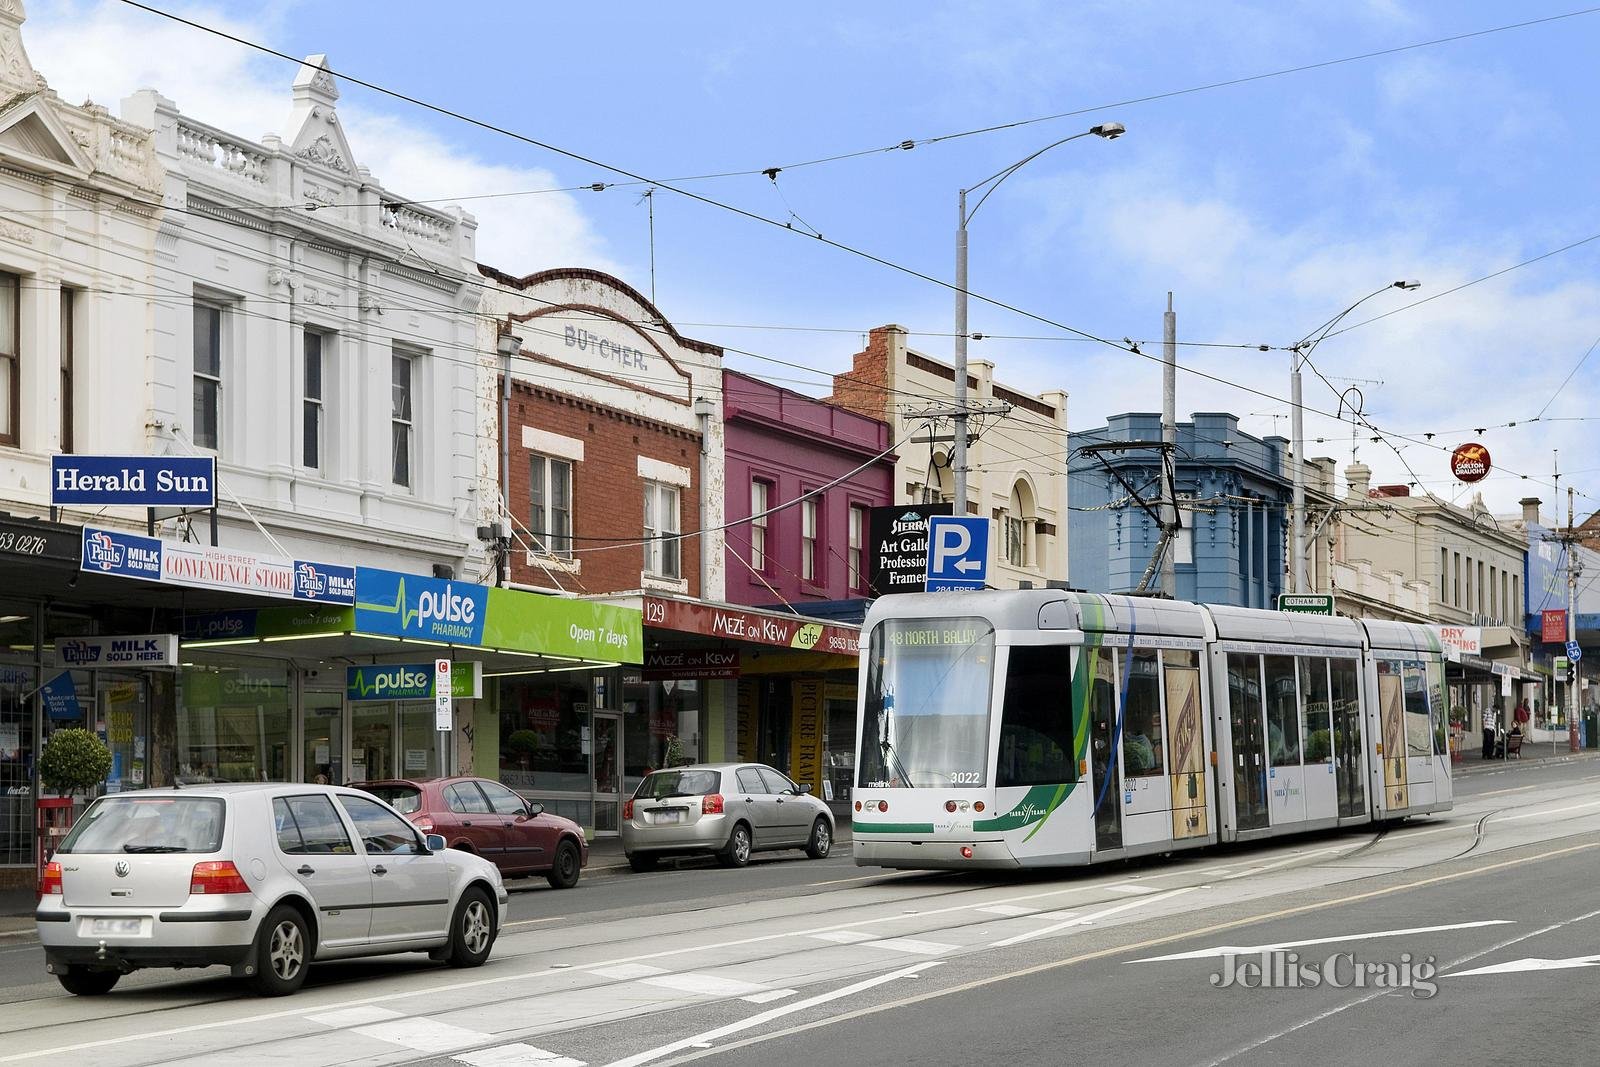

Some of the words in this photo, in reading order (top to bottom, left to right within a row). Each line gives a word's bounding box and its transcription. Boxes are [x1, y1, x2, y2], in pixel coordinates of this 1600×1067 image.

[1456, 462, 1484, 470] CARLTON
[56, 469, 147, 492] Herald
[156, 470, 209, 492] Sun
[891, 518, 929, 535] SIERRA
[15, 534, 47, 555] 0276
[880, 539, 898, 553] Art
[933, 523, 972, 574] P
[91, 543, 120, 563] Pauls
[128, 547, 159, 563] MILK
[205, 551, 227, 562] HIGH
[227, 554, 257, 566] STREET
[128, 561, 143, 570] SOLD
[143, 563, 159, 572] HERE
[880, 554, 928, 569] Professio
[166, 555, 251, 585] CONVENIENCE
[255, 568, 293, 591] STORE
[299, 574, 323, 592] Pauls
[328, 576, 354, 590] MILK
[328, 587, 341, 596] SOLD
[341, 588, 354, 597] HERE
[418, 584, 475, 628] pulse
[646, 602, 665, 623] 129
[208, 616, 244, 636] pulse
[323, 614, 342, 625] days
[432, 622, 474, 639] PHARMACY
[569, 623, 595, 643] Open
[598, 628, 605, 641] 7
[606, 629, 628, 647] days
[798, 626, 818, 646] Cafe
[889, 631, 903, 645] 48
[905, 630, 939, 645] NORTH
[1441, 628, 1465, 638] DRY
[111, 639, 158, 652] MILK
[829, 636, 847, 650] 9853
[67, 648, 97, 662] Pauls
[106, 652, 133, 662] SOLD
[136, 652, 164, 661] HERE
[1569, 650, 1580, 658] 36
[375, 667, 428, 694] pulse
[387, 685, 427, 697] PHARMACY
[950, 772, 980, 784] 3022
